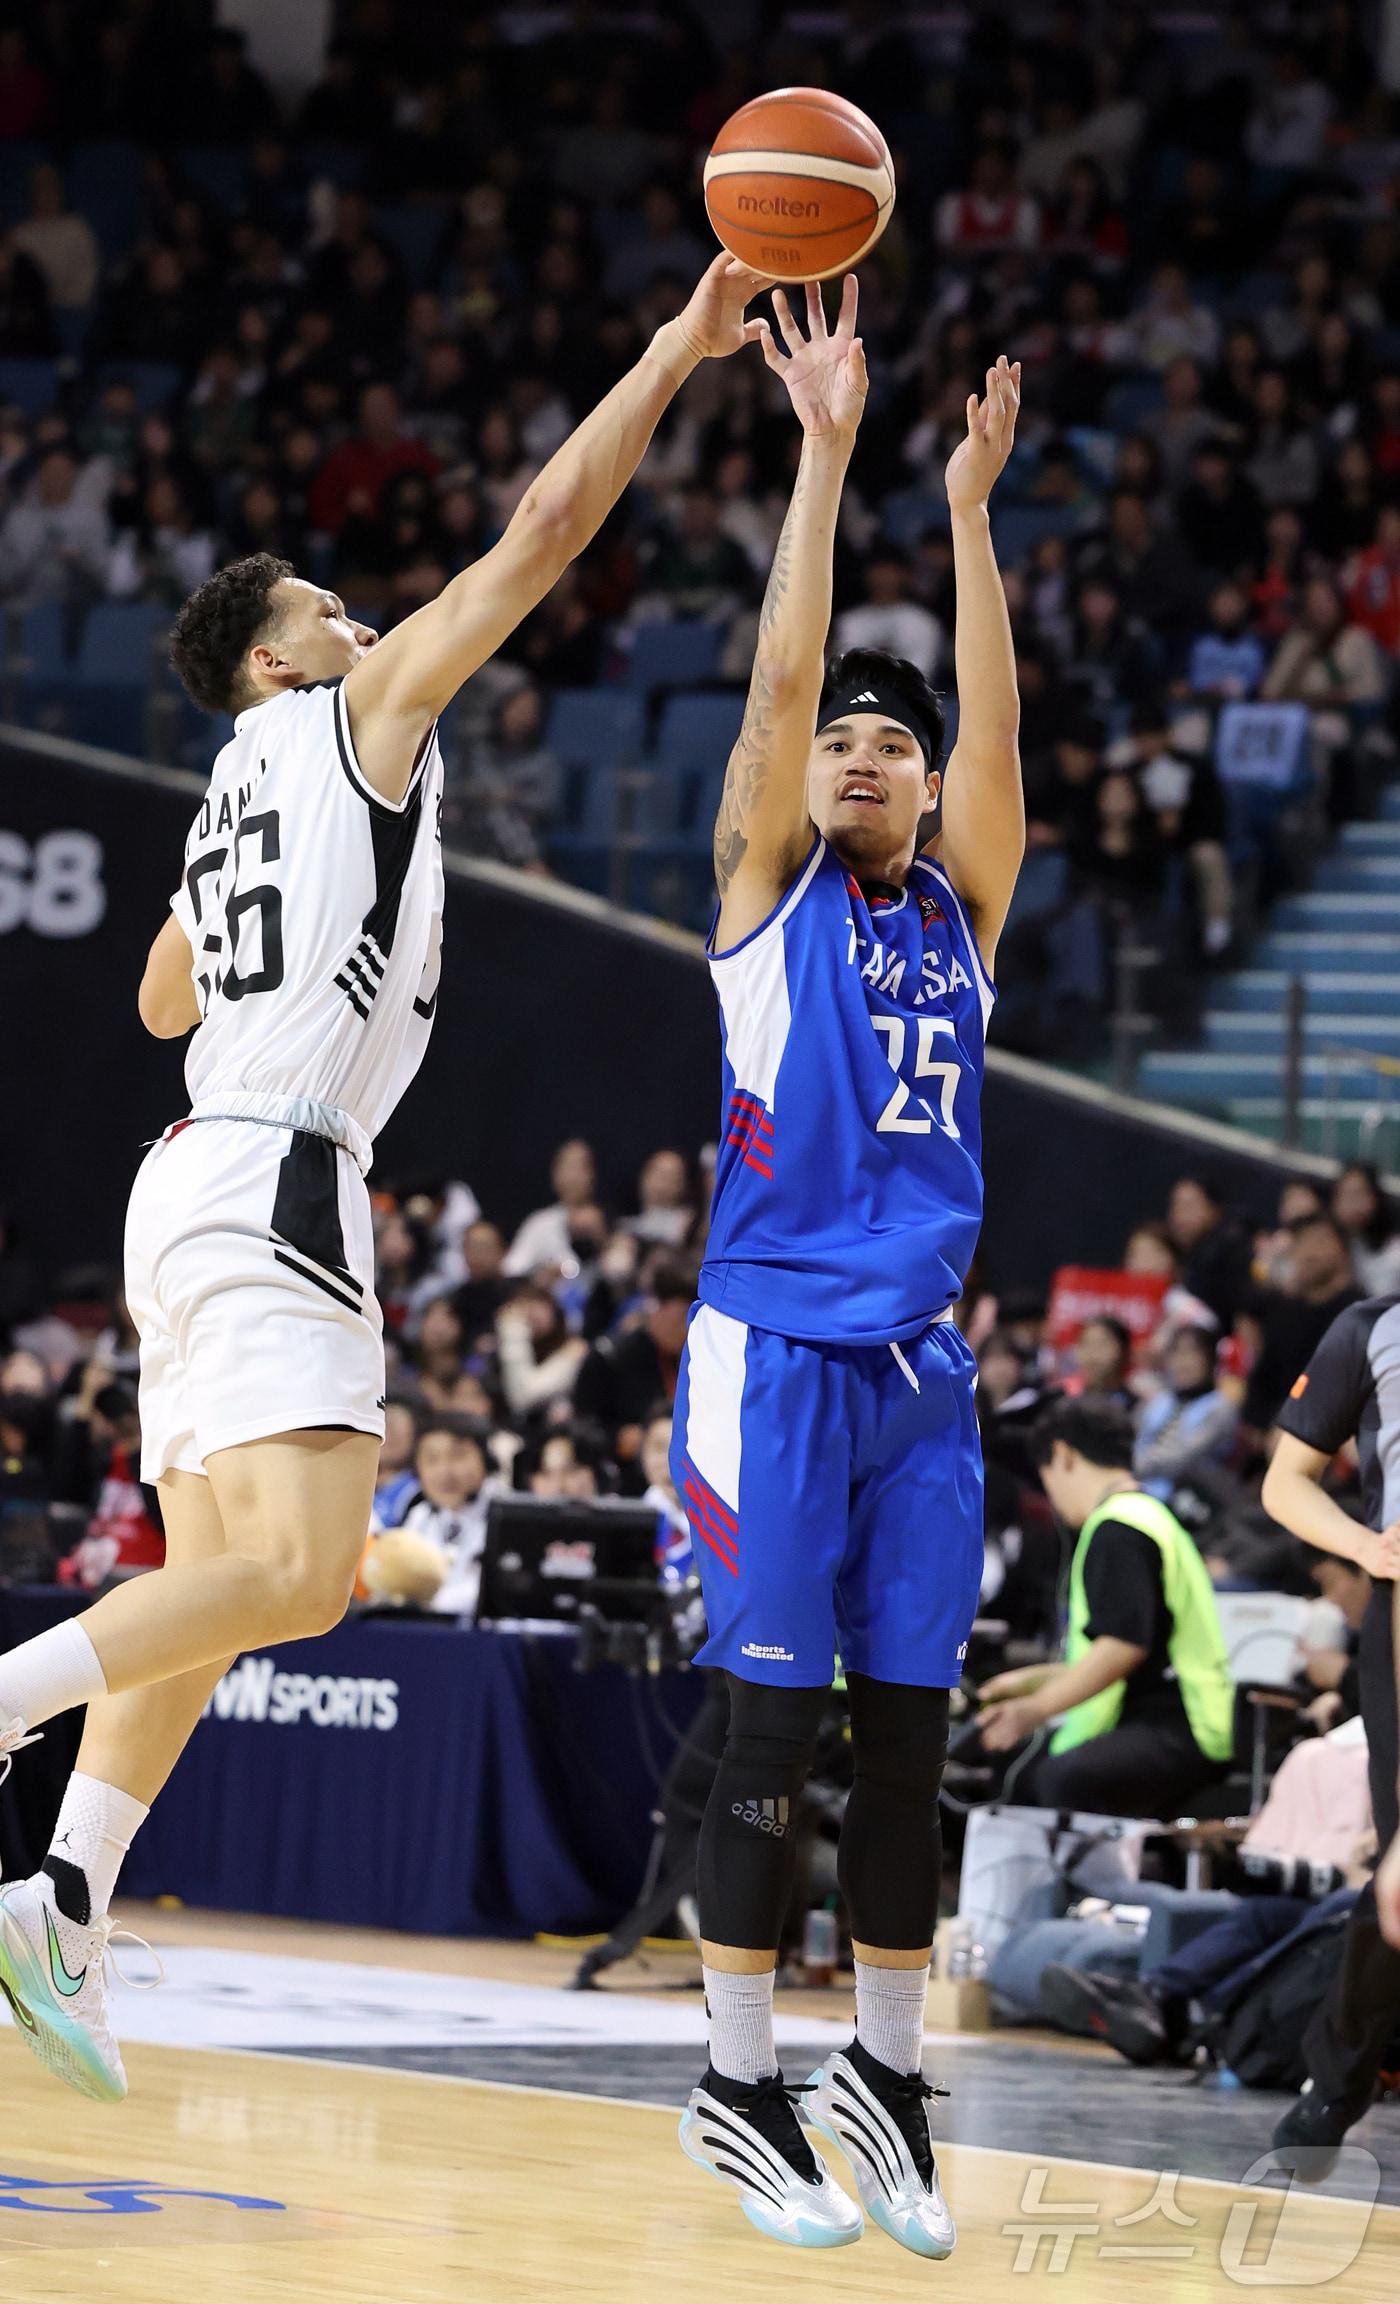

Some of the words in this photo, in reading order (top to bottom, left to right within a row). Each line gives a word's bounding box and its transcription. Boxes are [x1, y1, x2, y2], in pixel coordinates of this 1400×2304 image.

[738, 195, 821, 218] molten
[761, 246, 801, 263] FIBA
[869, 1014, 962, 1138] 25
[741, 1645, 795, 1662] Illustrated
[748, 1642, 786, 1654] Sports
[270, 1671, 400, 1732] SPORTS
